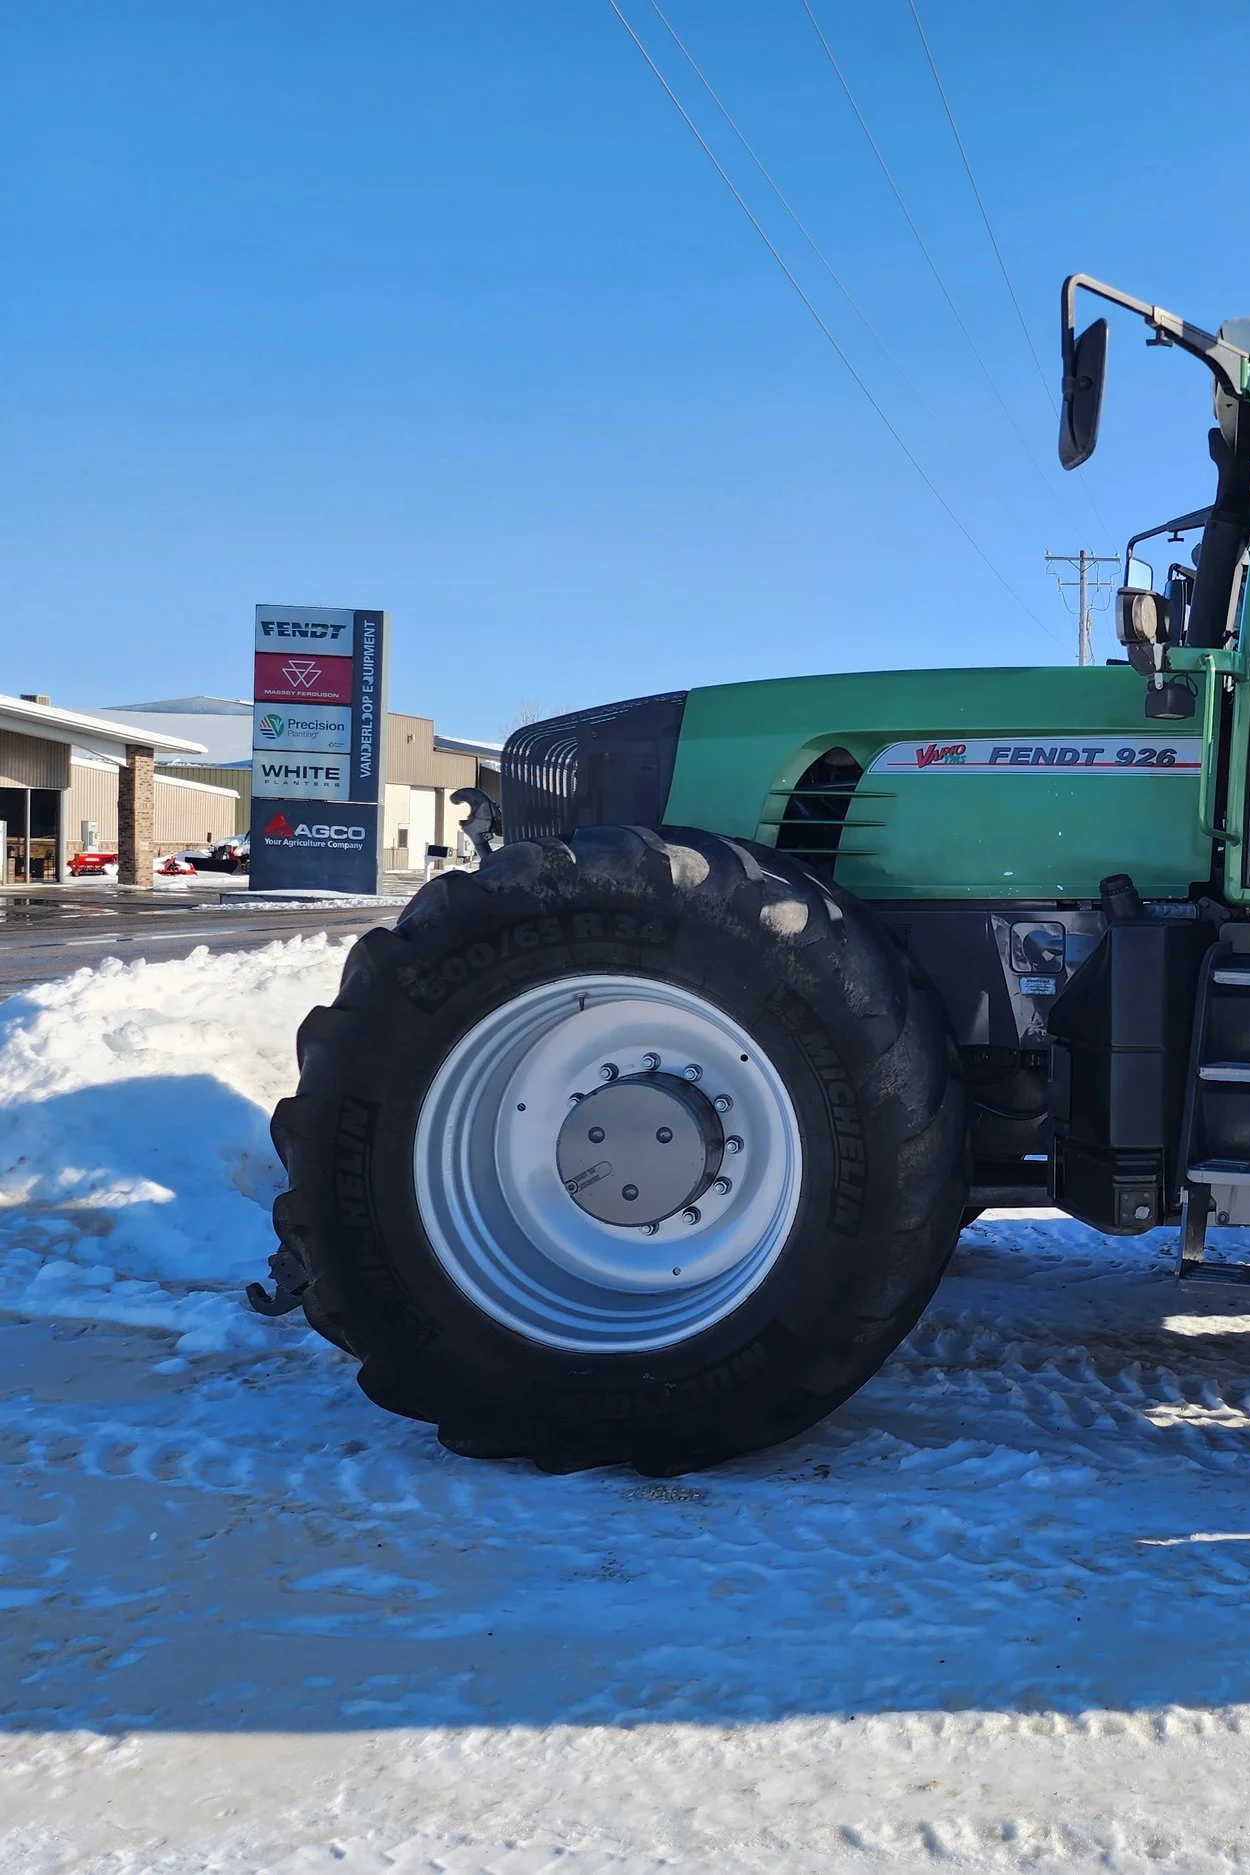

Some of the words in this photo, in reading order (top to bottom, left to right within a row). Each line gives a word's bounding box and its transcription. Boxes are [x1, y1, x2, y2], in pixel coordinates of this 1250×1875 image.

[260, 621, 347, 640] FENDT
[362, 620, 376, 693] EQUIPMENT
[297, 690, 339, 698] FERGUSON
[288, 718, 345, 732] Precision
[360, 696, 374, 779] VANDERLOOP
[988, 746, 1104, 766] FENDT
[1114, 748, 1177, 767] 926
[261, 764, 340, 780] WHITE
[264, 780, 340, 788] PLANTERS
[294, 824, 366, 840] AGCO
[264, 838, 281, 847] Your
[283, 838, 326, 848] Agriculture
[327, 841, 363, 851] Company
[573, 912, 603, 939] R
[611, 914, 667, 943] 34
[800, 1029, 867, 1235] MICHELIN
